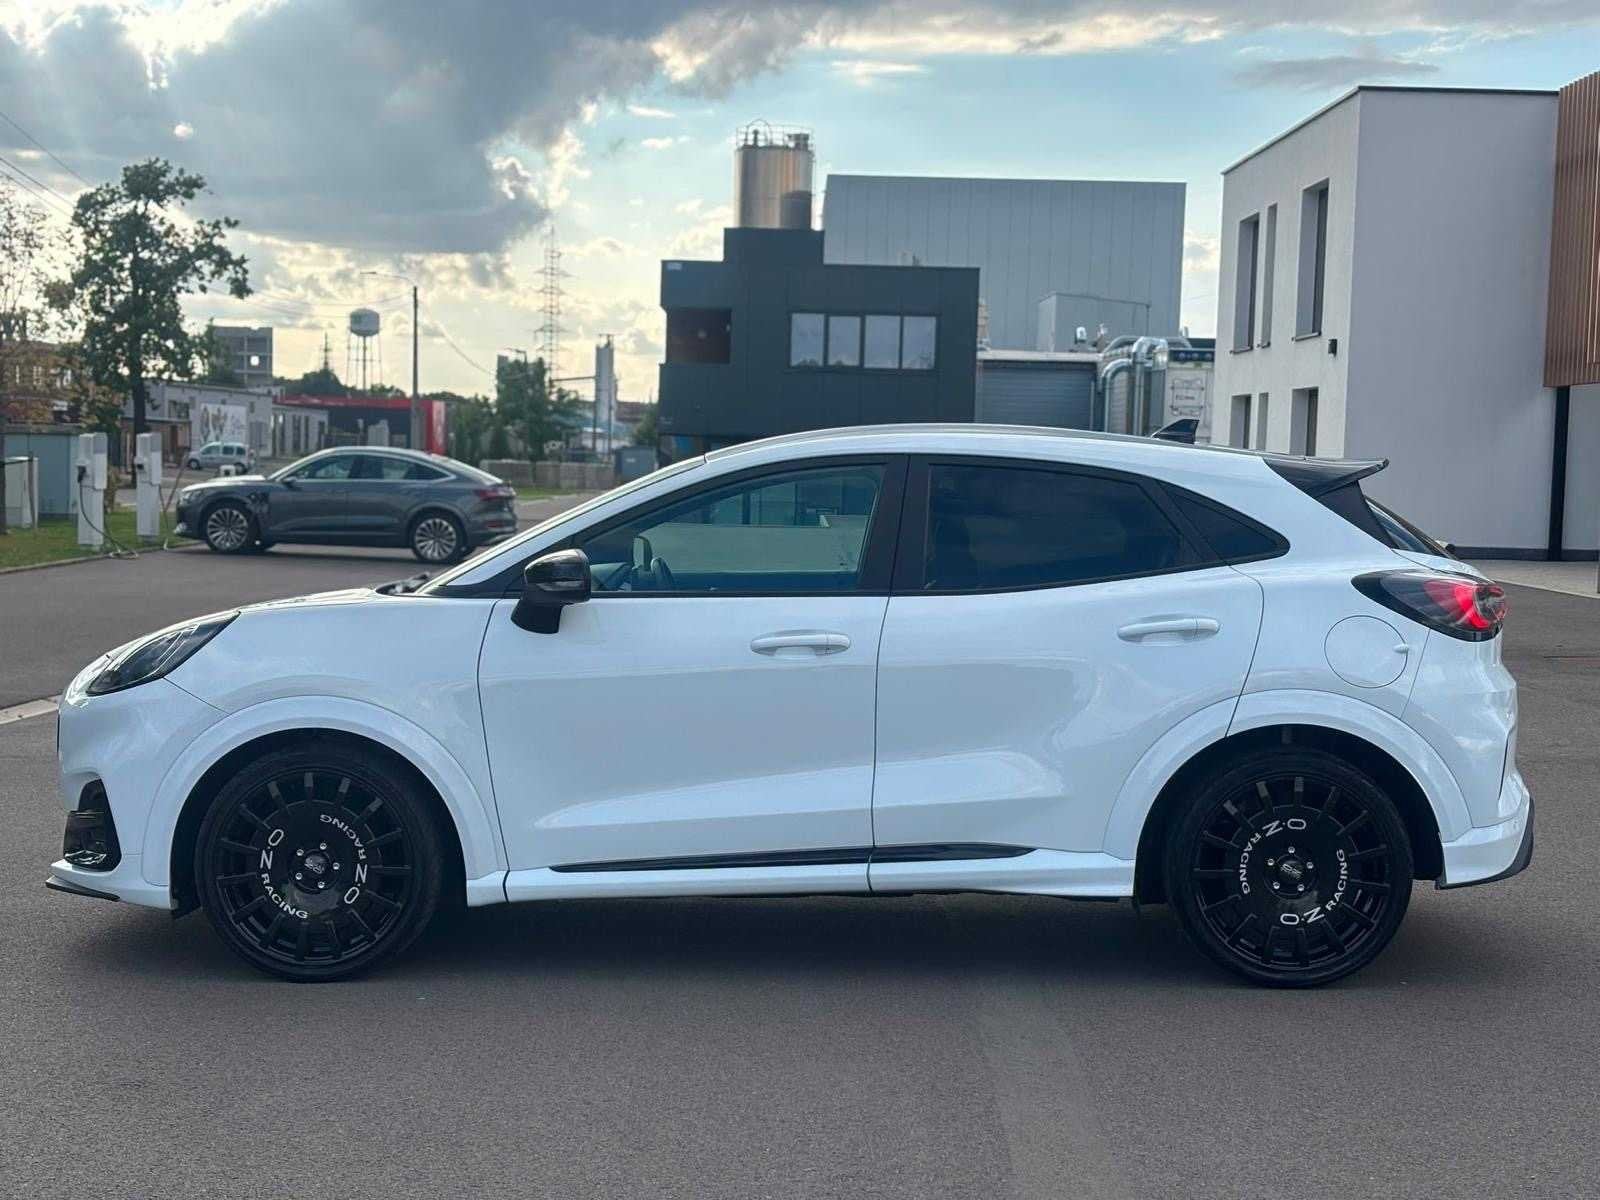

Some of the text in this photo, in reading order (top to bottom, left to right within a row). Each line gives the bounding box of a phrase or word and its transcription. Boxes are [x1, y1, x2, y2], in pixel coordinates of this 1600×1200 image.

[319, 814, 367, 860] RACING
[1239, 833, 1262, 894] RACING
[261, 873, 309, 919] RACING
[1325, 849, 1348, 911] RACING
